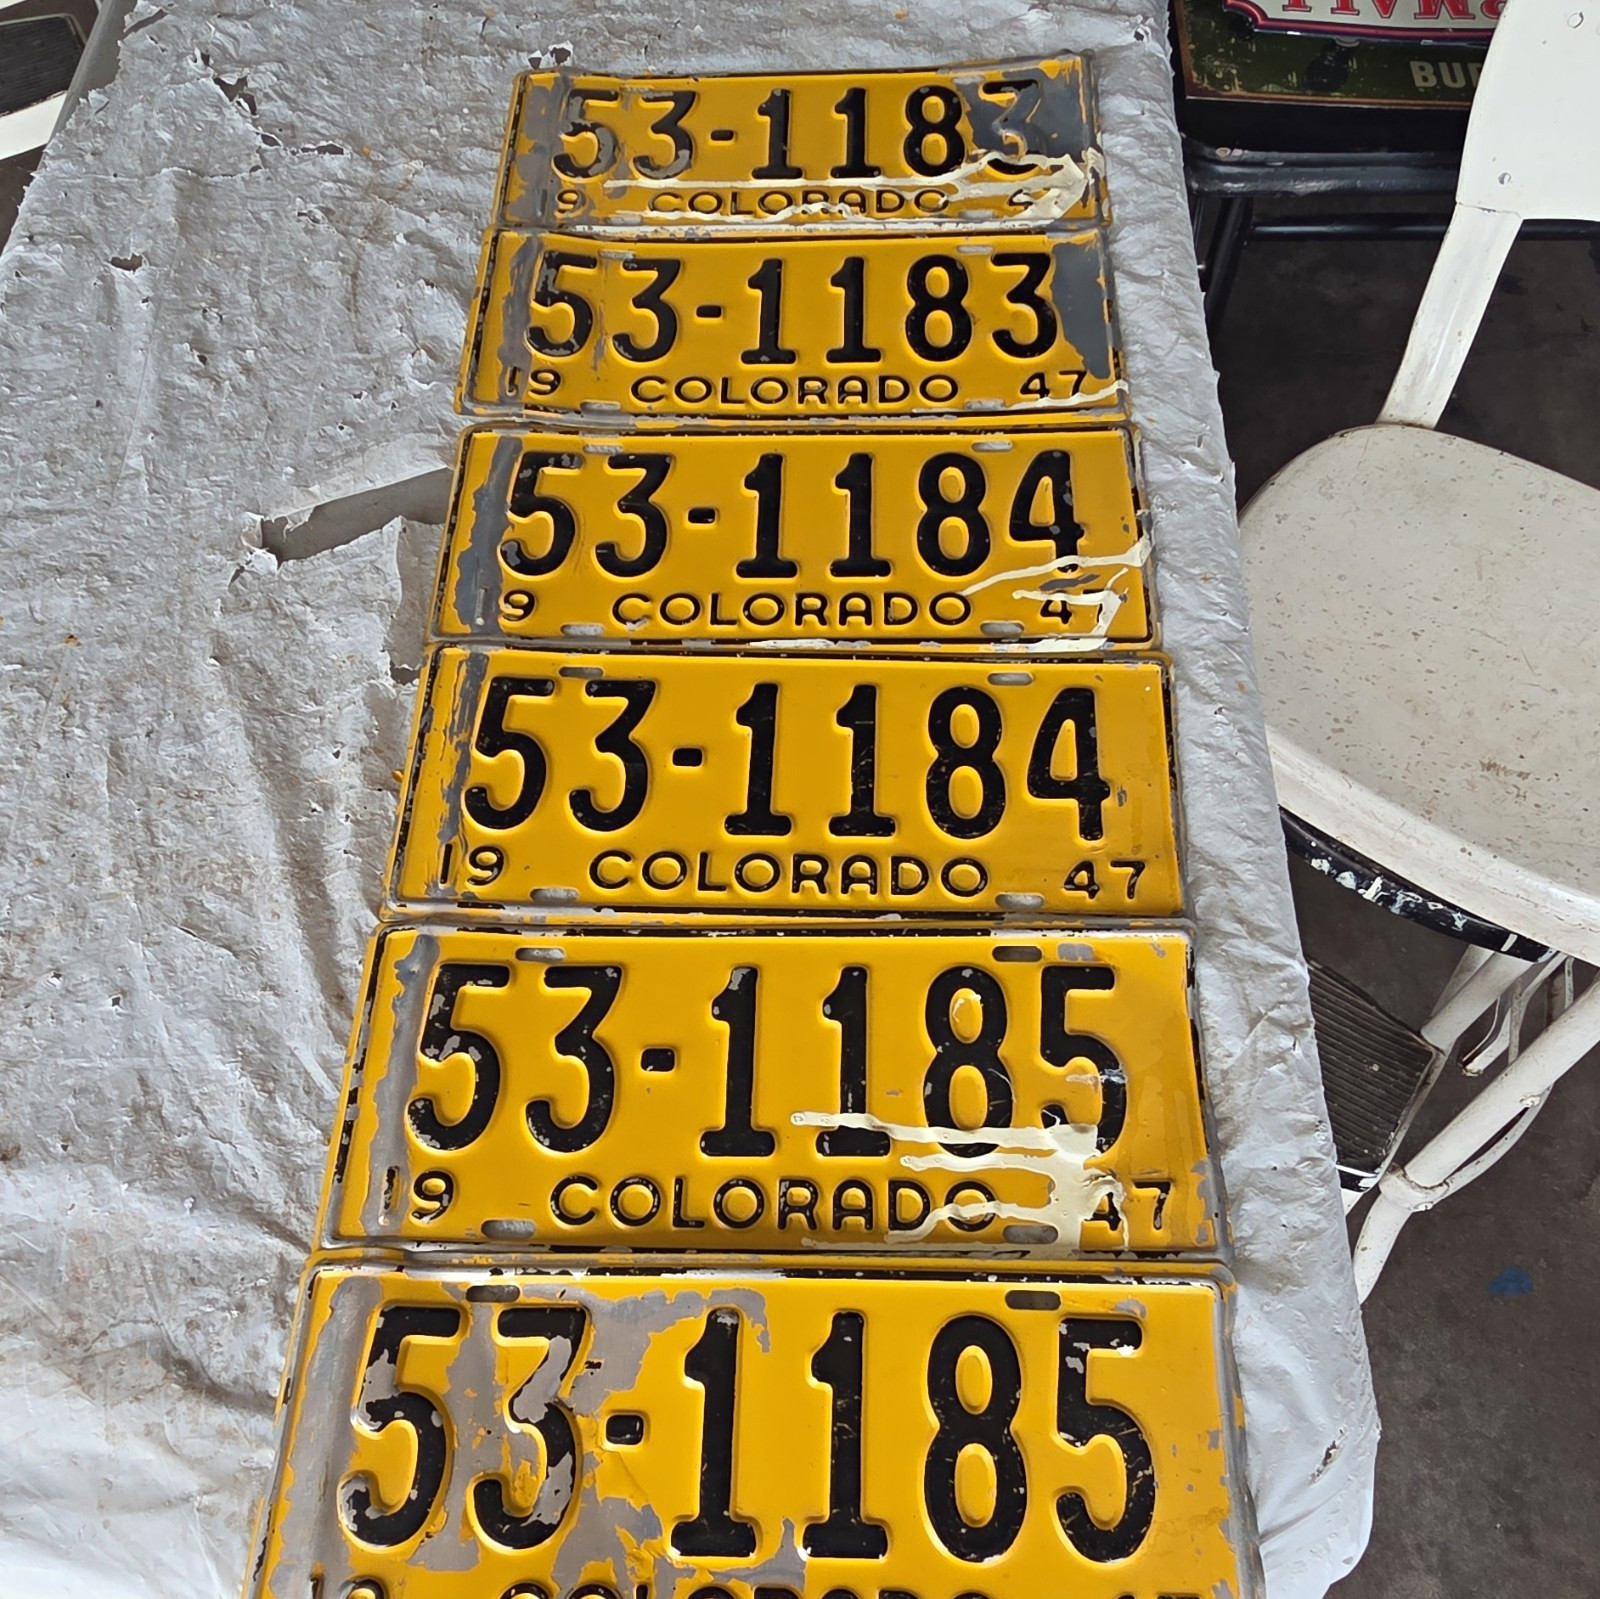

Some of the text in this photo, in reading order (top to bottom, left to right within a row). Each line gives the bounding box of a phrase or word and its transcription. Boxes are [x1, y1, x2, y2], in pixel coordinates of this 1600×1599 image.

[552, 79, 1048, 179] 53-1183
[649, 189, 950, 216] COLORADO
[527, 252, 1057, 364] 53-1183
[508, 366, 1087, 405] 19 COLORADO 47
[500, 450, 1084, 578] 53-1184
[612, 591, 971, 627] COLORADO
[464, 676, 1110, 841] 53-1184
[440, 843, 1147, 899] 19 COLORADO 47
[407, 963, 1128, 1158] 53-1185
[550, 1173, 997, 1232] COLORADO
[339, 1305, 1154, 1564] 53-1185
